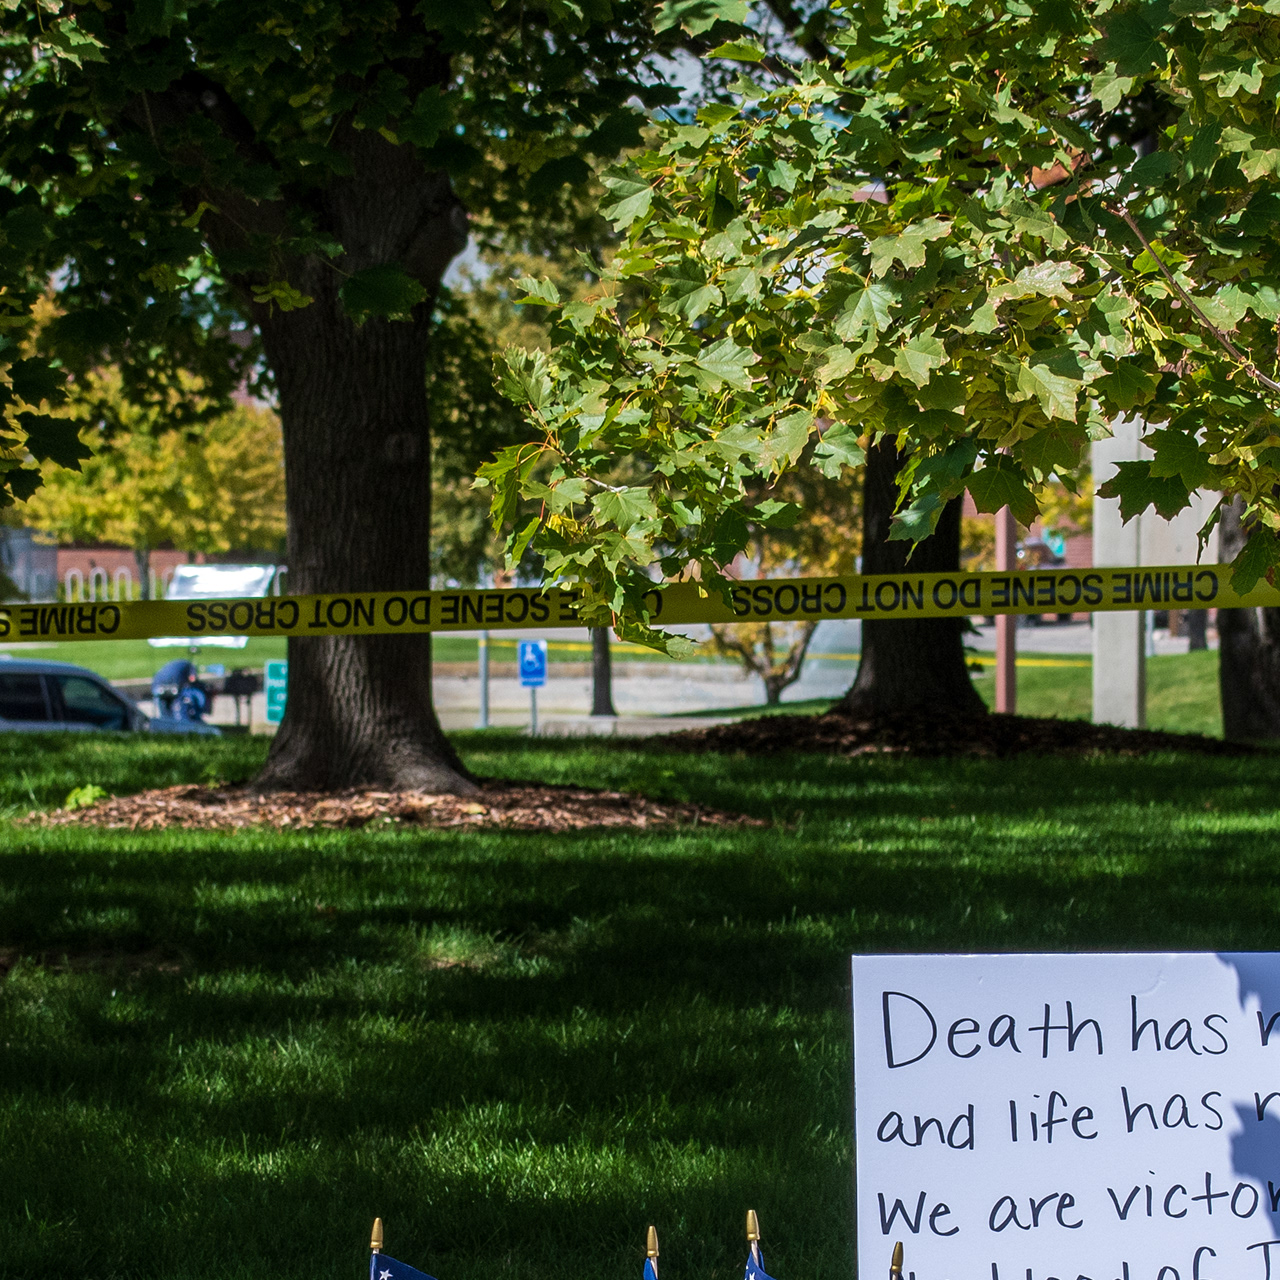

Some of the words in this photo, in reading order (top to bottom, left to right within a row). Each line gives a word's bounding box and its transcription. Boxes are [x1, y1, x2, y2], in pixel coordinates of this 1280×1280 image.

[733, 581, 847, 616] CROSS
[855, 579, 925, 612] NOT
[932, 578, 981, 609] DO
[991, 573, 1104, 607] SCENE
[1111, 570, 1219, 603] CRIME
[20, 603, 121, 637] CRIME
[186, 598, 300, 632] CROSS
[308, 596, 376, 629] NOT
[382, 595, 431, 626] DO
[440, 591, 551, 625] SCENE
[882, 991, 1103, 1068] Death
[1130, 994, 1229, 1055] has
[876, 1103, 976, 1150] and
[1009, 1090, 1098, 1144] life
[1121, 1086, 1223, 1134] has
[989, 1192, 1084, 1232] are
